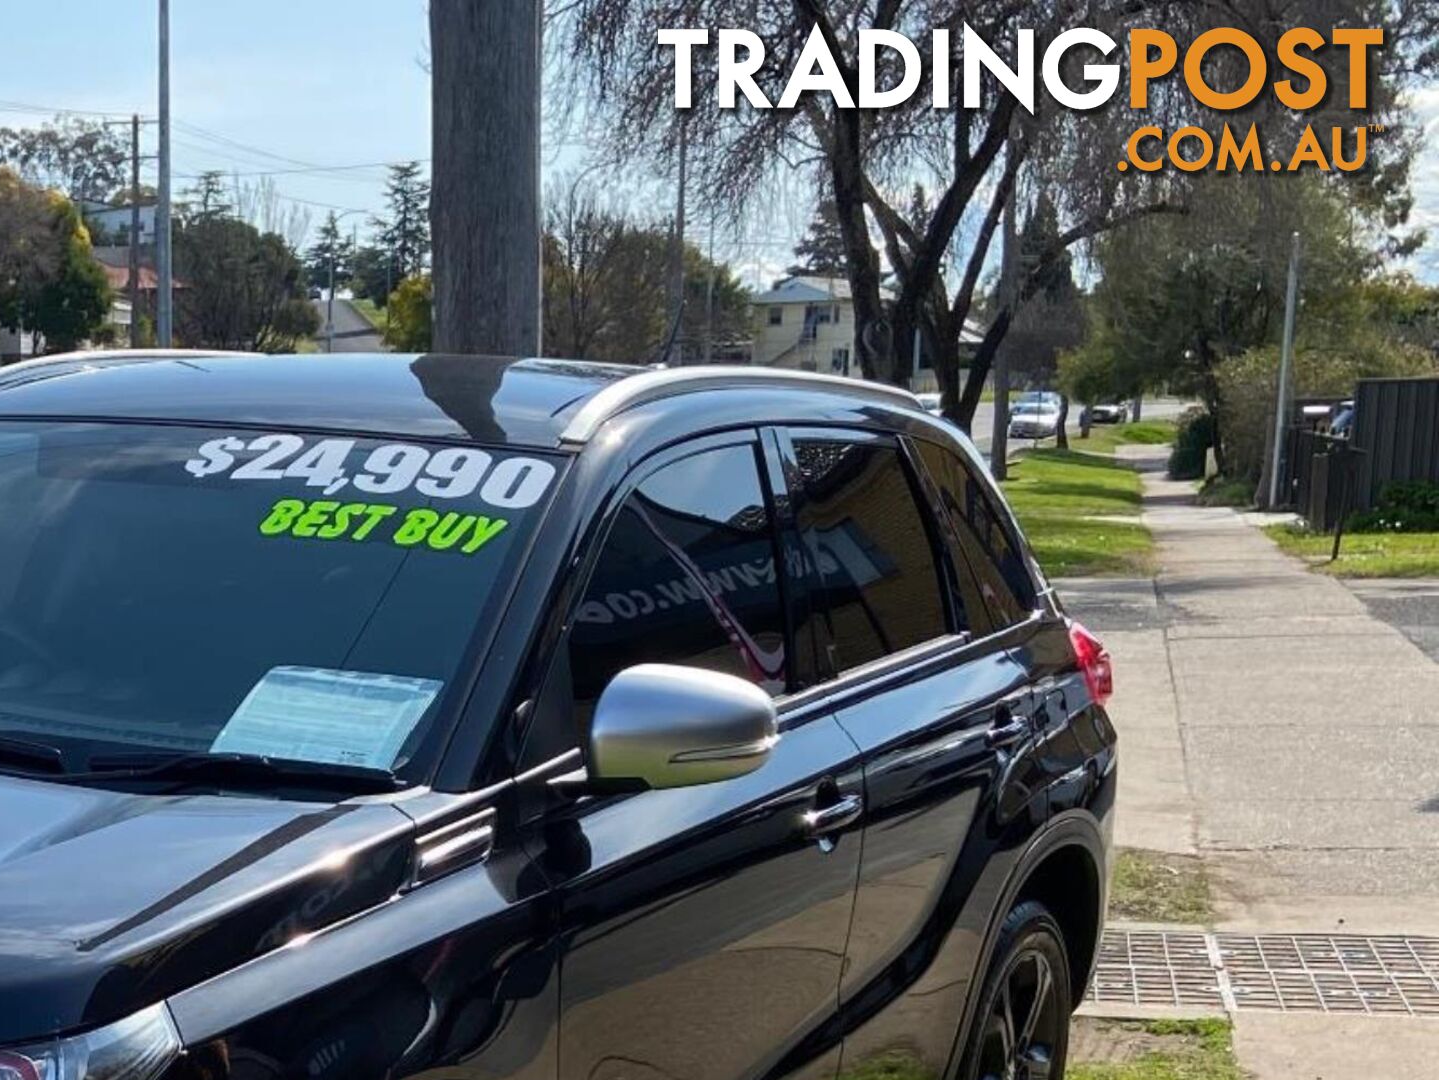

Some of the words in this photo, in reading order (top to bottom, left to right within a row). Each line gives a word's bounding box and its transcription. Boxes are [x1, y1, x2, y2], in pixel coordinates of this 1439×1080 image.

[185, 434, 556, 509] $24,990
[258, 499, 399, 542] BEST
[391, 507, 508, 555] BUY
